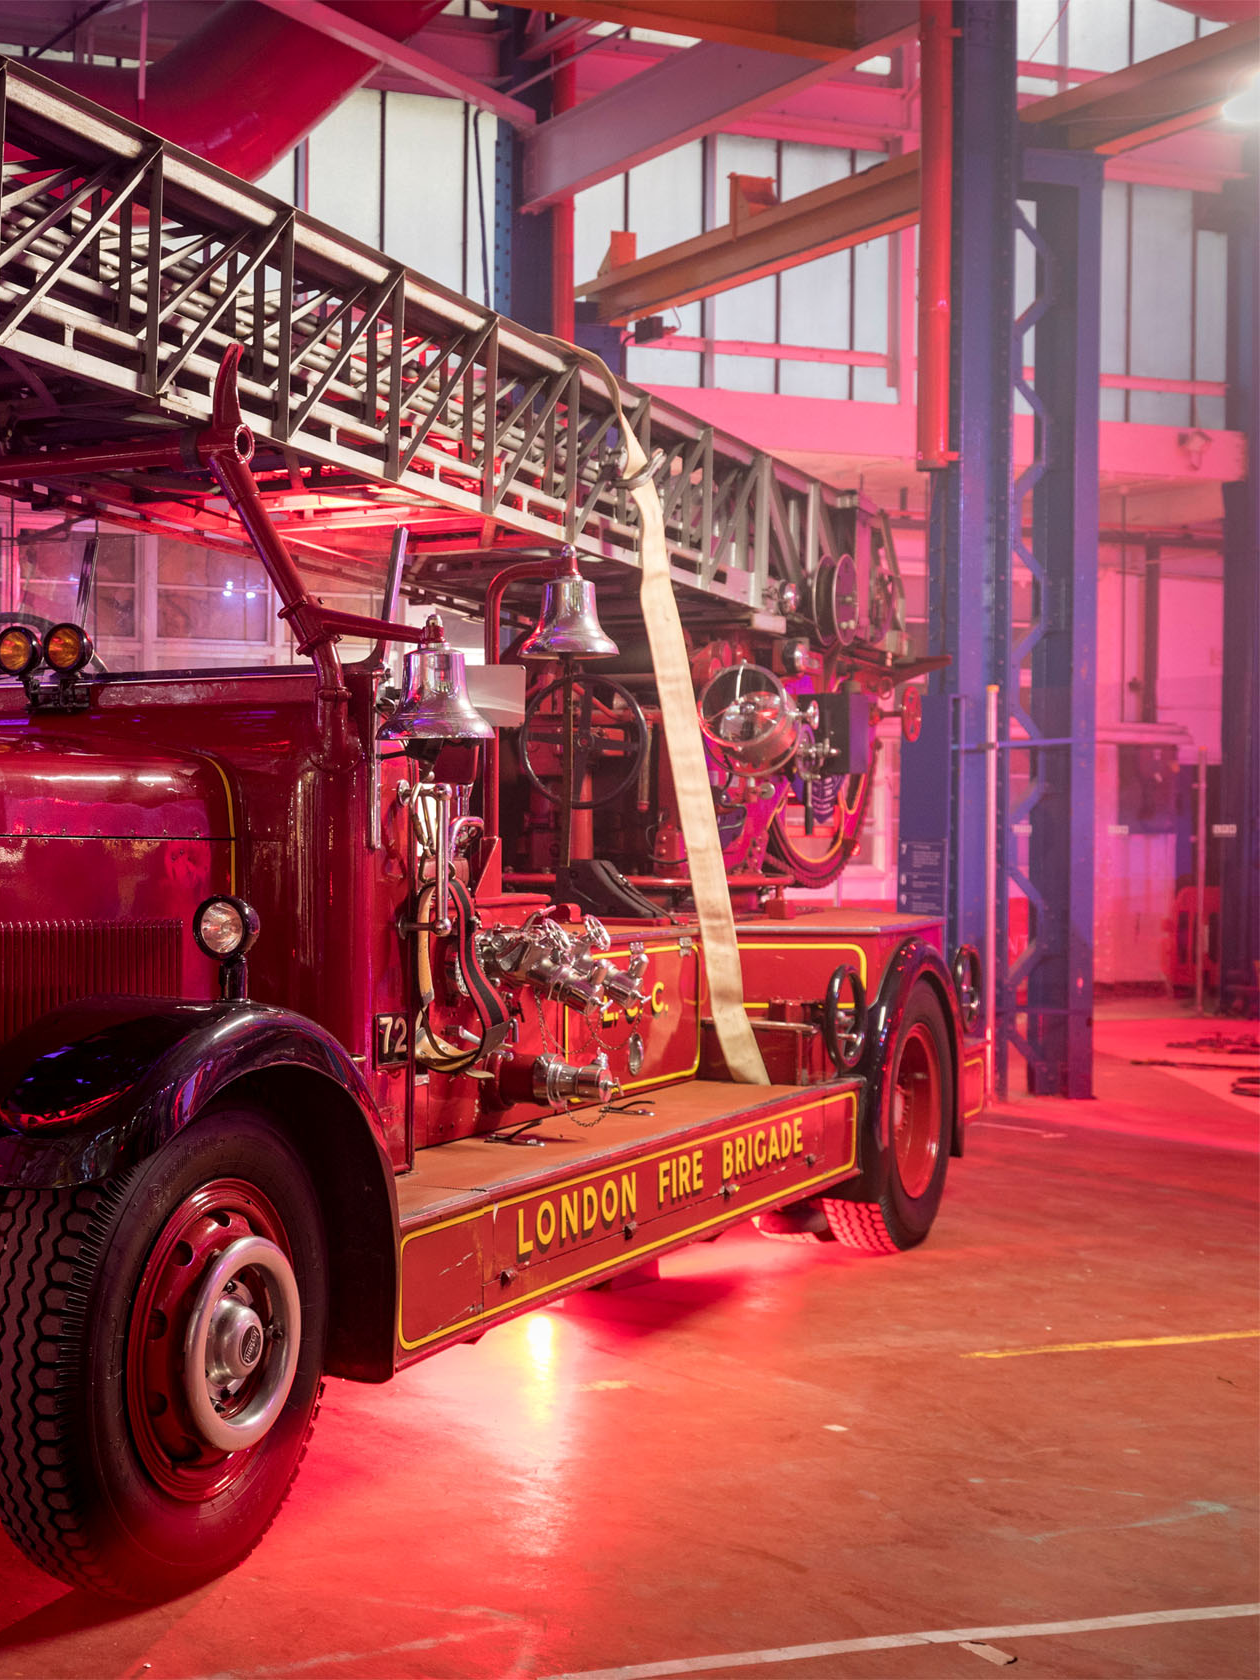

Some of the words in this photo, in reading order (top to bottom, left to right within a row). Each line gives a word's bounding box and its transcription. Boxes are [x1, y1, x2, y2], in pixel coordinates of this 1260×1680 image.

[379, 1017, 407, 1054] 72
[518, 1171, 637, 1255] LONDON
[658, 1150, 703, 1203] FIRE
[722, 1117, 803, 1180] BRIGADE
